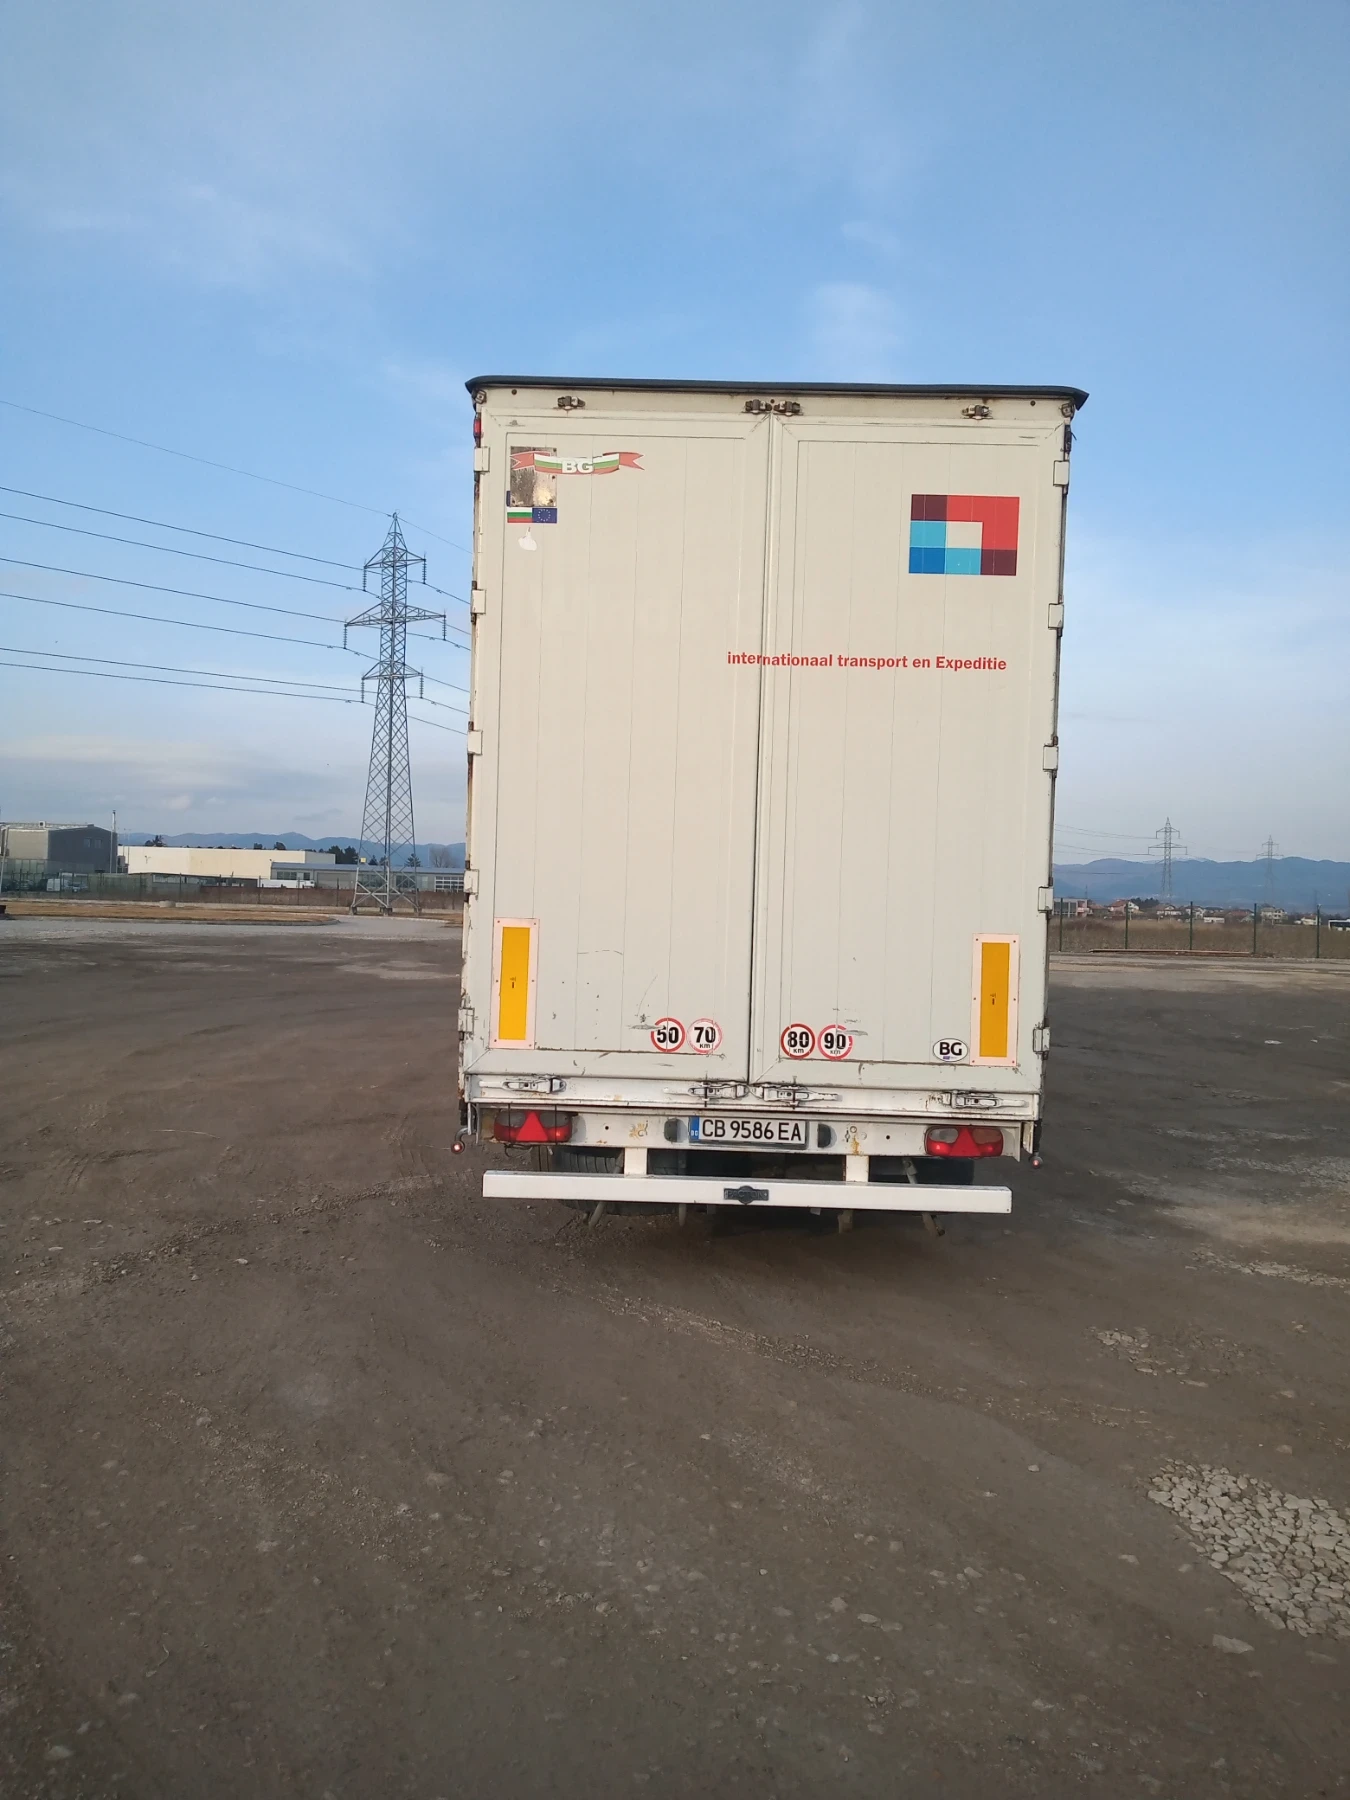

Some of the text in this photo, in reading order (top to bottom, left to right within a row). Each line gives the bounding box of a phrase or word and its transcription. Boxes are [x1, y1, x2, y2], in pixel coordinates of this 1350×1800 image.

[561, 458, 594, 474] BG
[727, 651, 1007, 671] internationaal transport en Expeditie
[656, 1025, 679, 1044] 50
[694, 1026, 716, 1044] 70
[787, 1031, 810, 1048] 80
[824, 1032, 847, 1050] 90
[939, 1041, 963, 1056] BG
[730, 1120, 775, 1140] 9586
